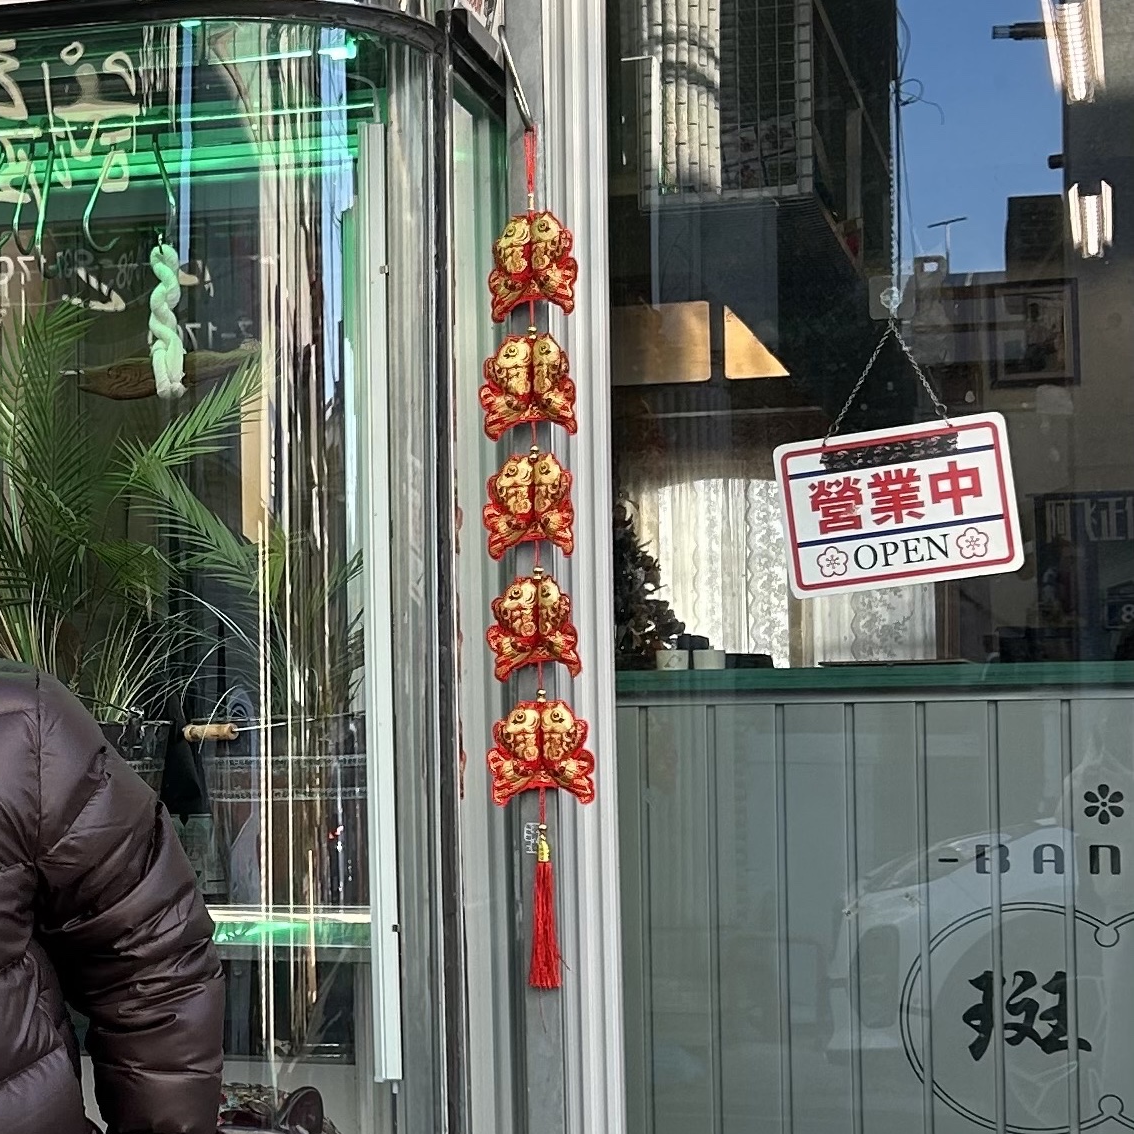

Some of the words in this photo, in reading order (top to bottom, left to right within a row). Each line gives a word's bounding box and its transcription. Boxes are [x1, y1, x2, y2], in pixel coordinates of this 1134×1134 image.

[808, 460, 983, 535] 營業中
[853, 533, 951, 570] OPEN
